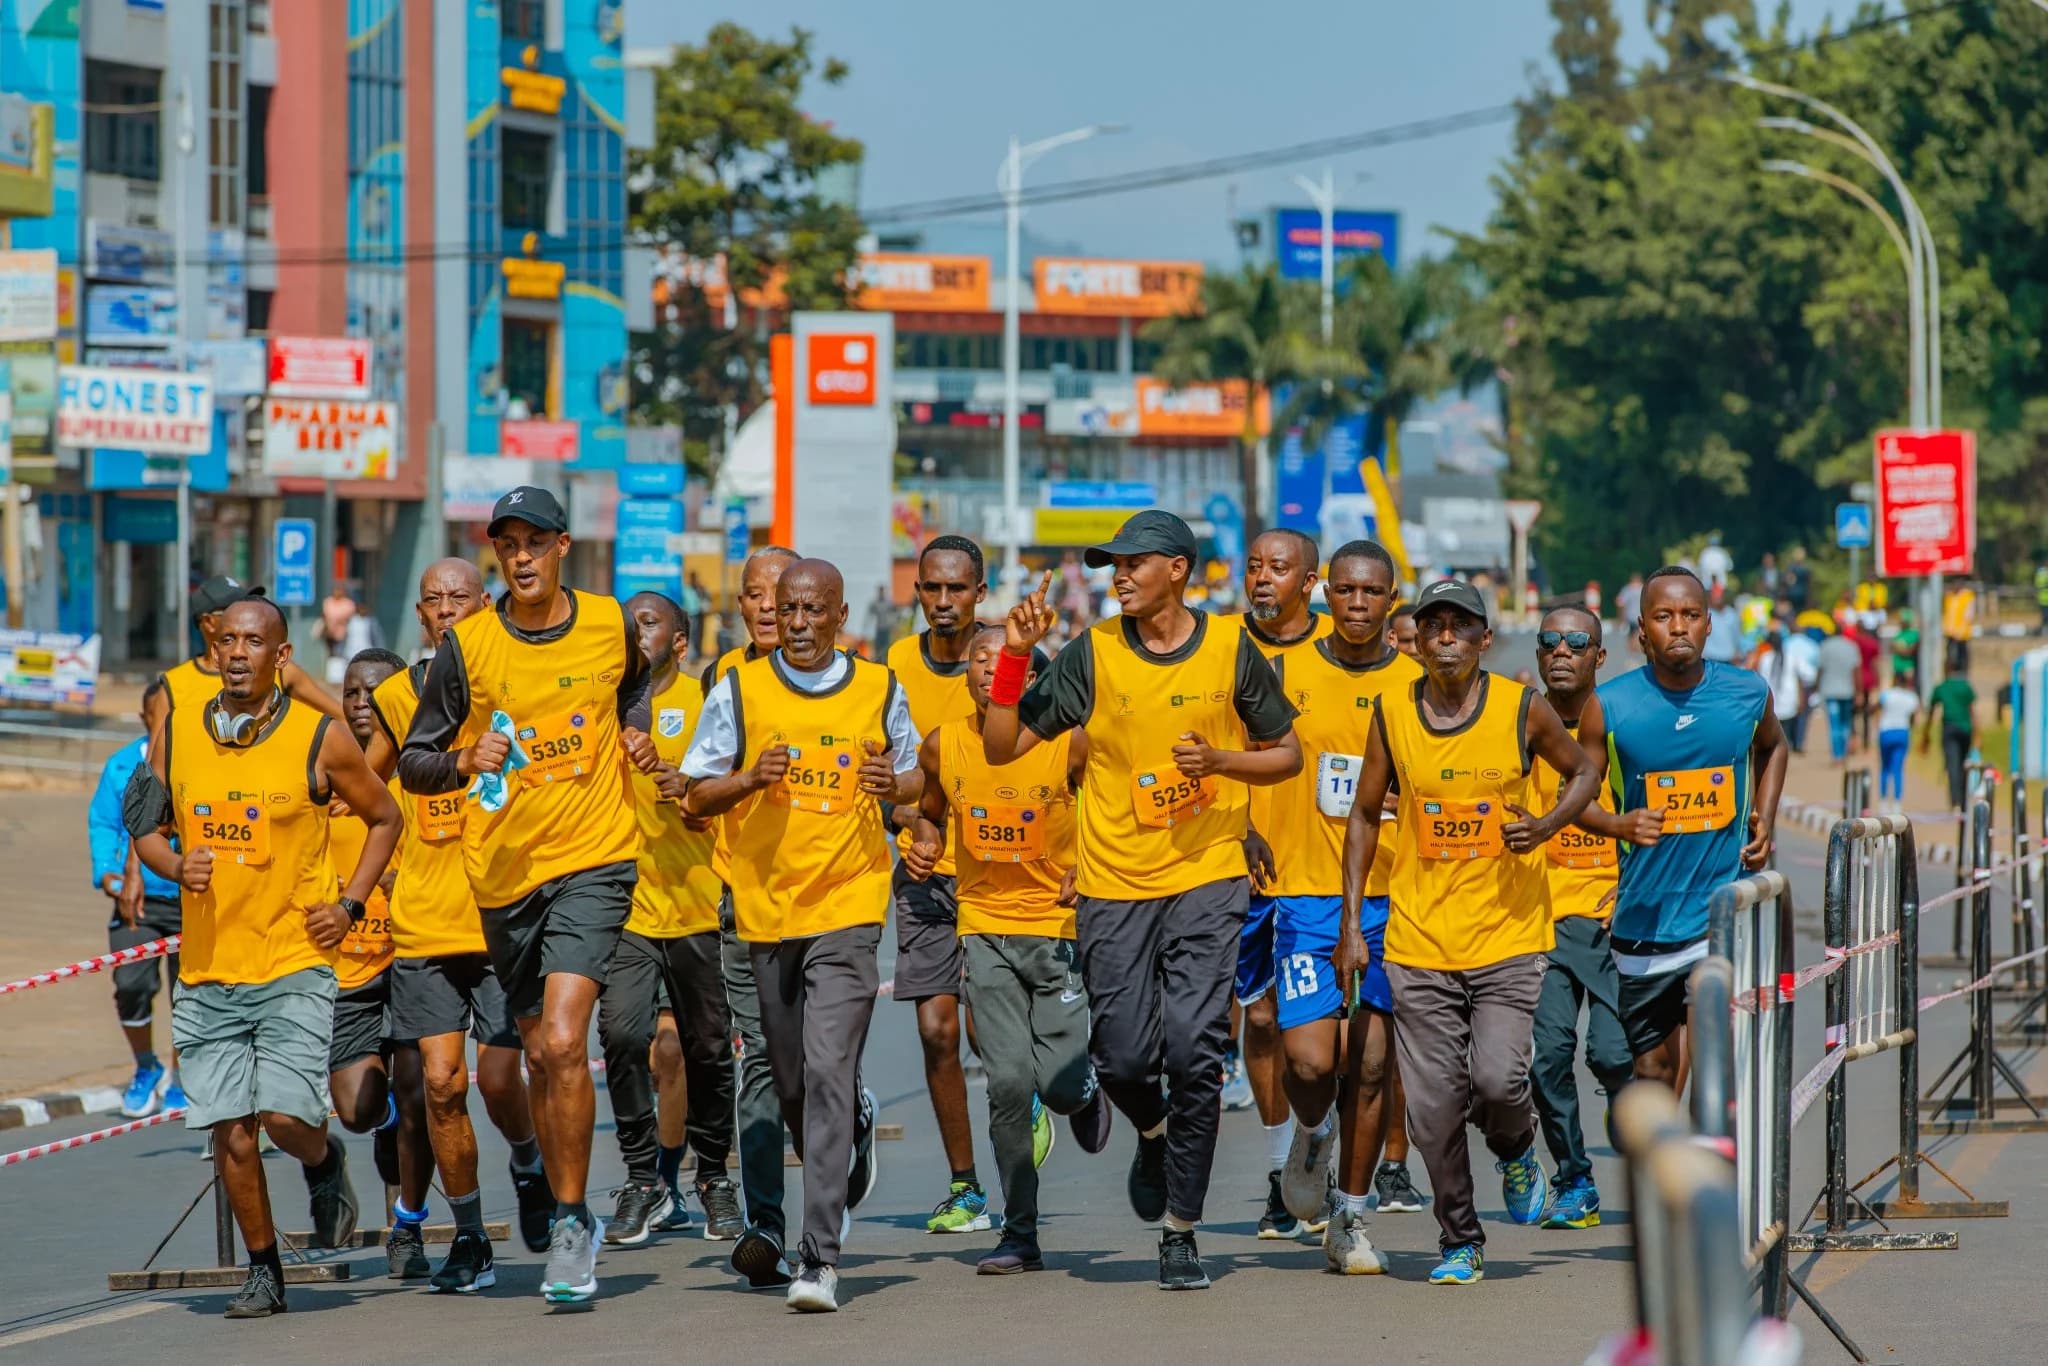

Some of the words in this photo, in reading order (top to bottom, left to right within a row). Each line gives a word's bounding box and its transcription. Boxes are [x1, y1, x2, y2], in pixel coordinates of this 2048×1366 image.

[59, 375, 206, 416] HONEST
[271, 401, 389, 427] PHARMA
[58, 415, 207, 444] SUPERMARKET
[283, 529, 306, 560] P
[531, 734, 582, 762] 5389
[789, 767, 841, 789] 5612
[1152, 776, 1200, 807] 5259
[1667, 790, 1718, 810] 5744
[202, 822, 252, 841] 5426
[978, 824, 1025, 842] 5381
[1433, 820, 1484, 838] 5297
[1281, 952, 1319, 1001] 13
